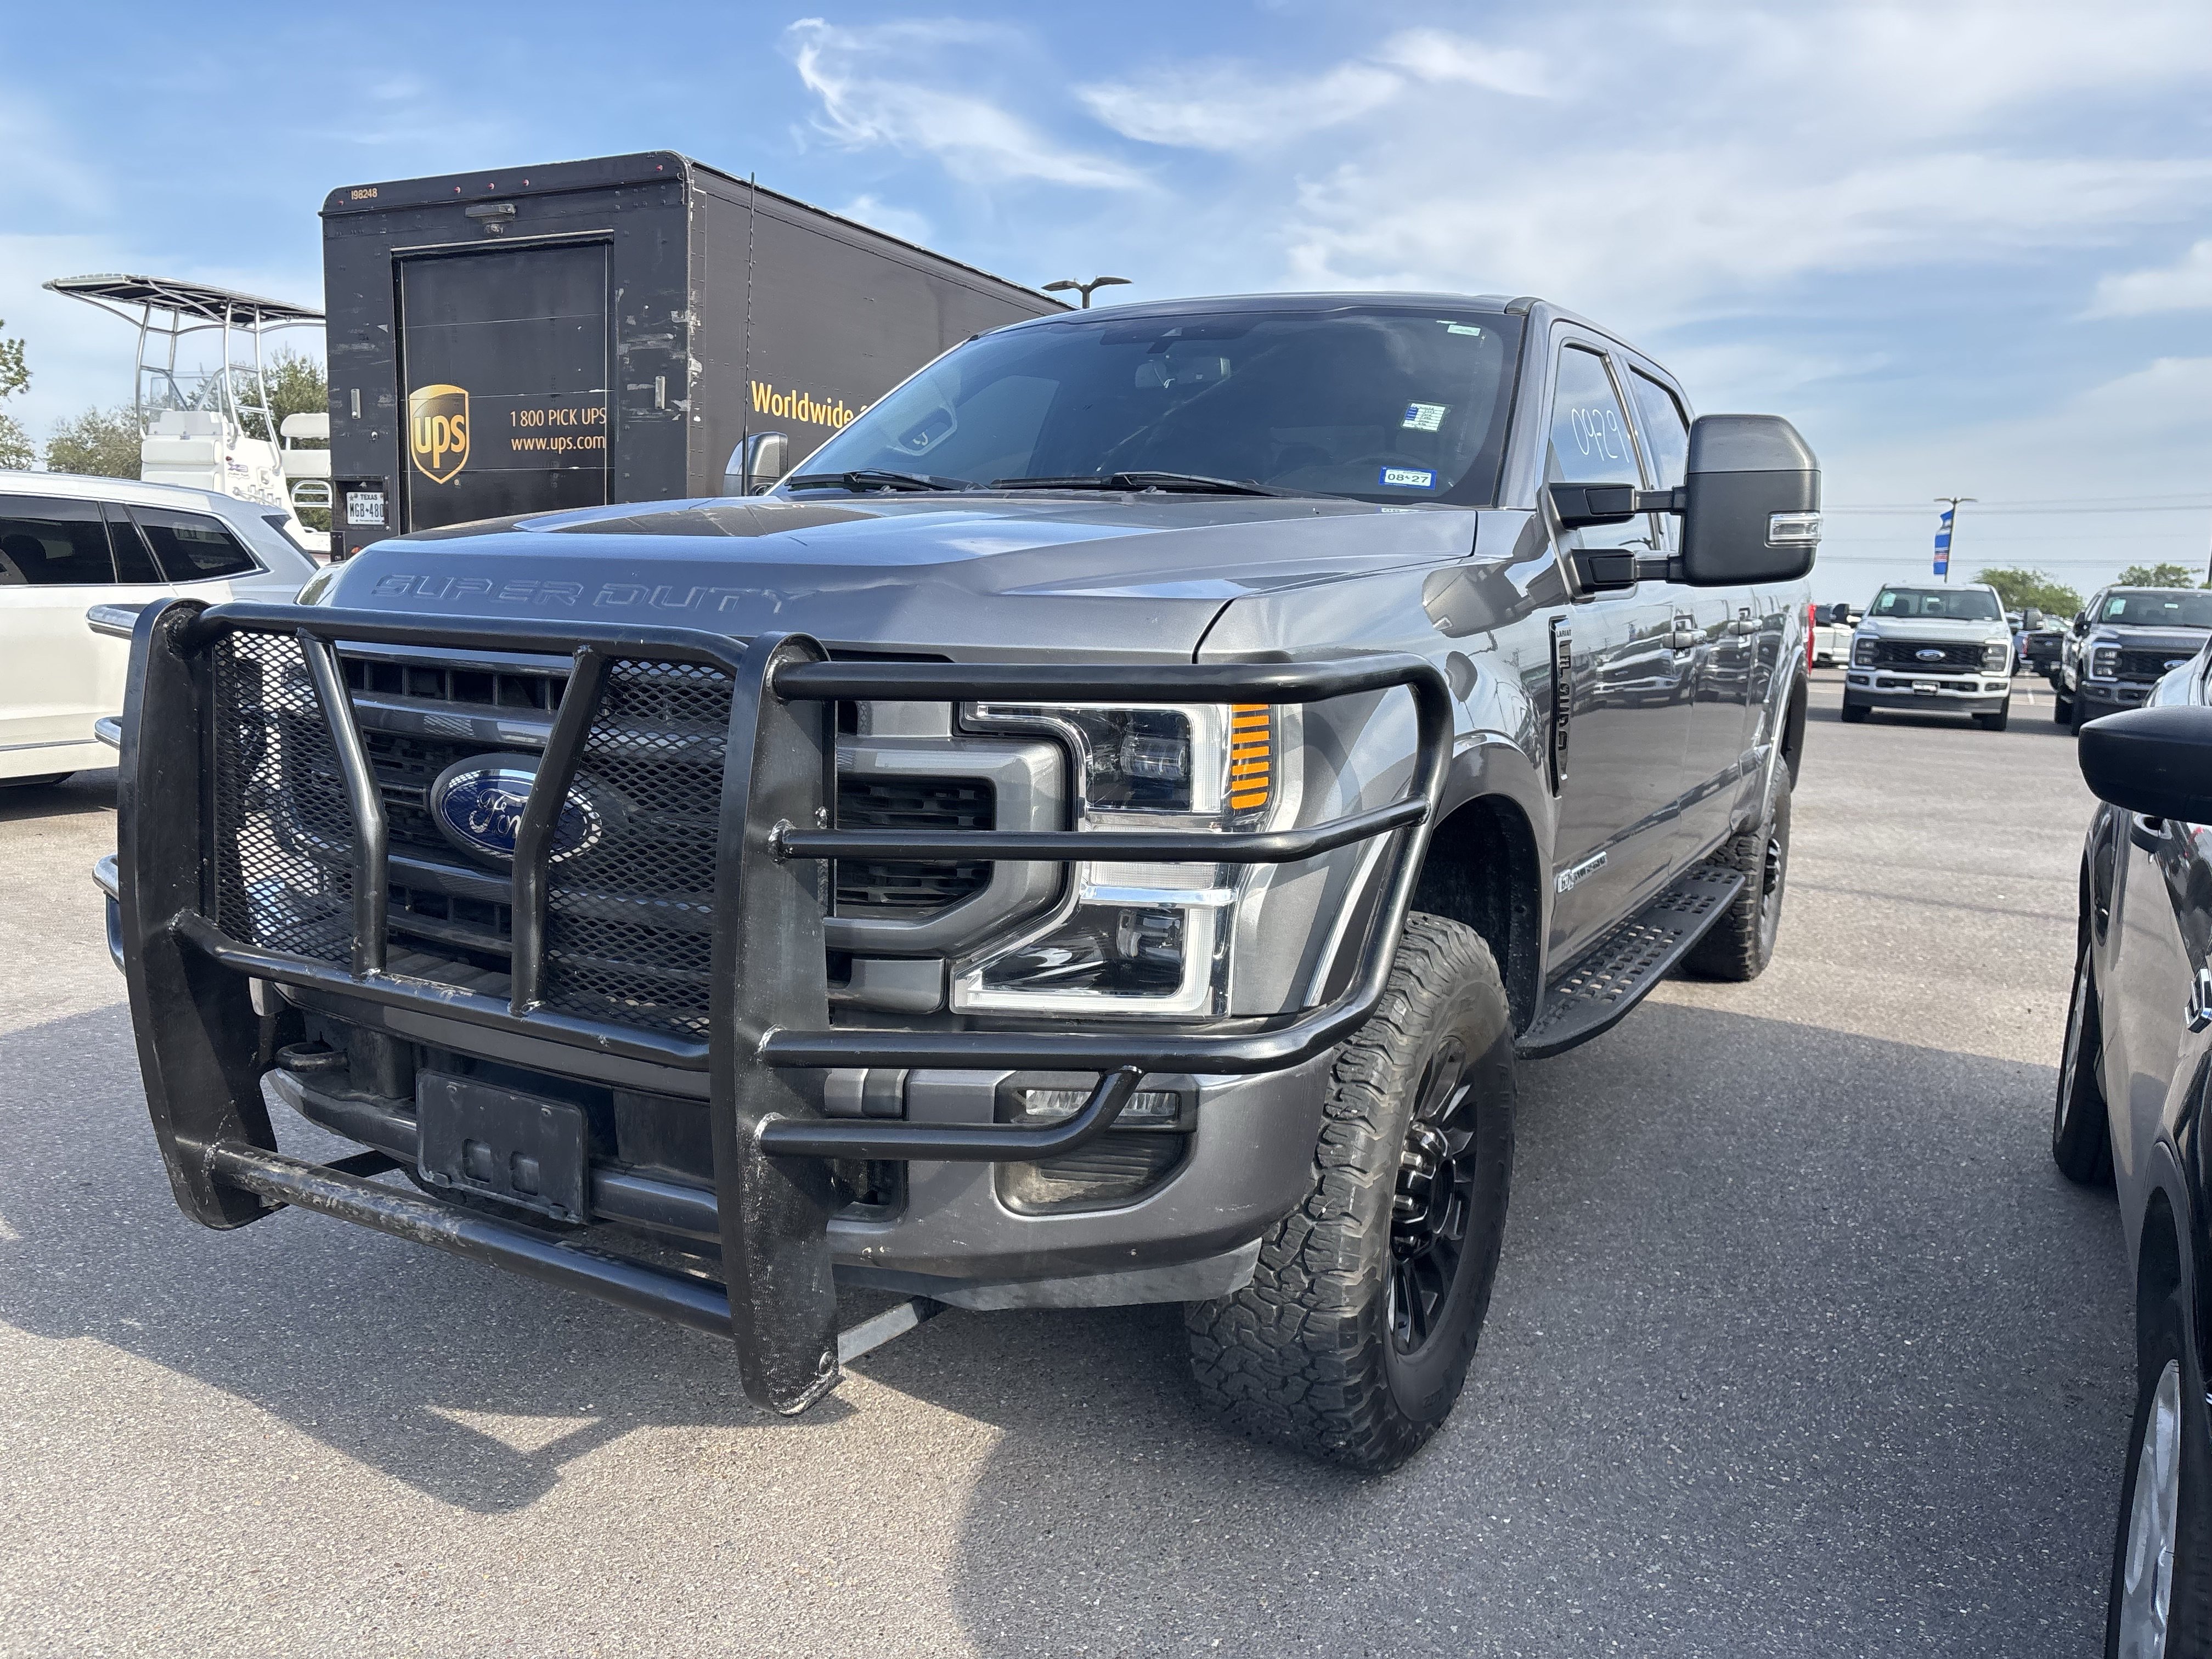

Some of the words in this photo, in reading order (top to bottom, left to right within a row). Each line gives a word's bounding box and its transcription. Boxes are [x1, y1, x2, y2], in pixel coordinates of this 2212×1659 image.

[351, 188, 378, 200] 198248
[751, 380, 854, 428] Worldwide
[510, 411, 516, 427] 1
[520, 409, 544, 427] 800
[549, 408, 578, 426] PICK
[582, 407, 606, 425] UPS
[414, 414, 465, 469] ups
[511, 436, 606, 455] www.ups.com
[371, 574, 584, 606] SUPER
[592, 582, 816, 614] DUTY
[1556, 629, 1572, 637] LARIAT
